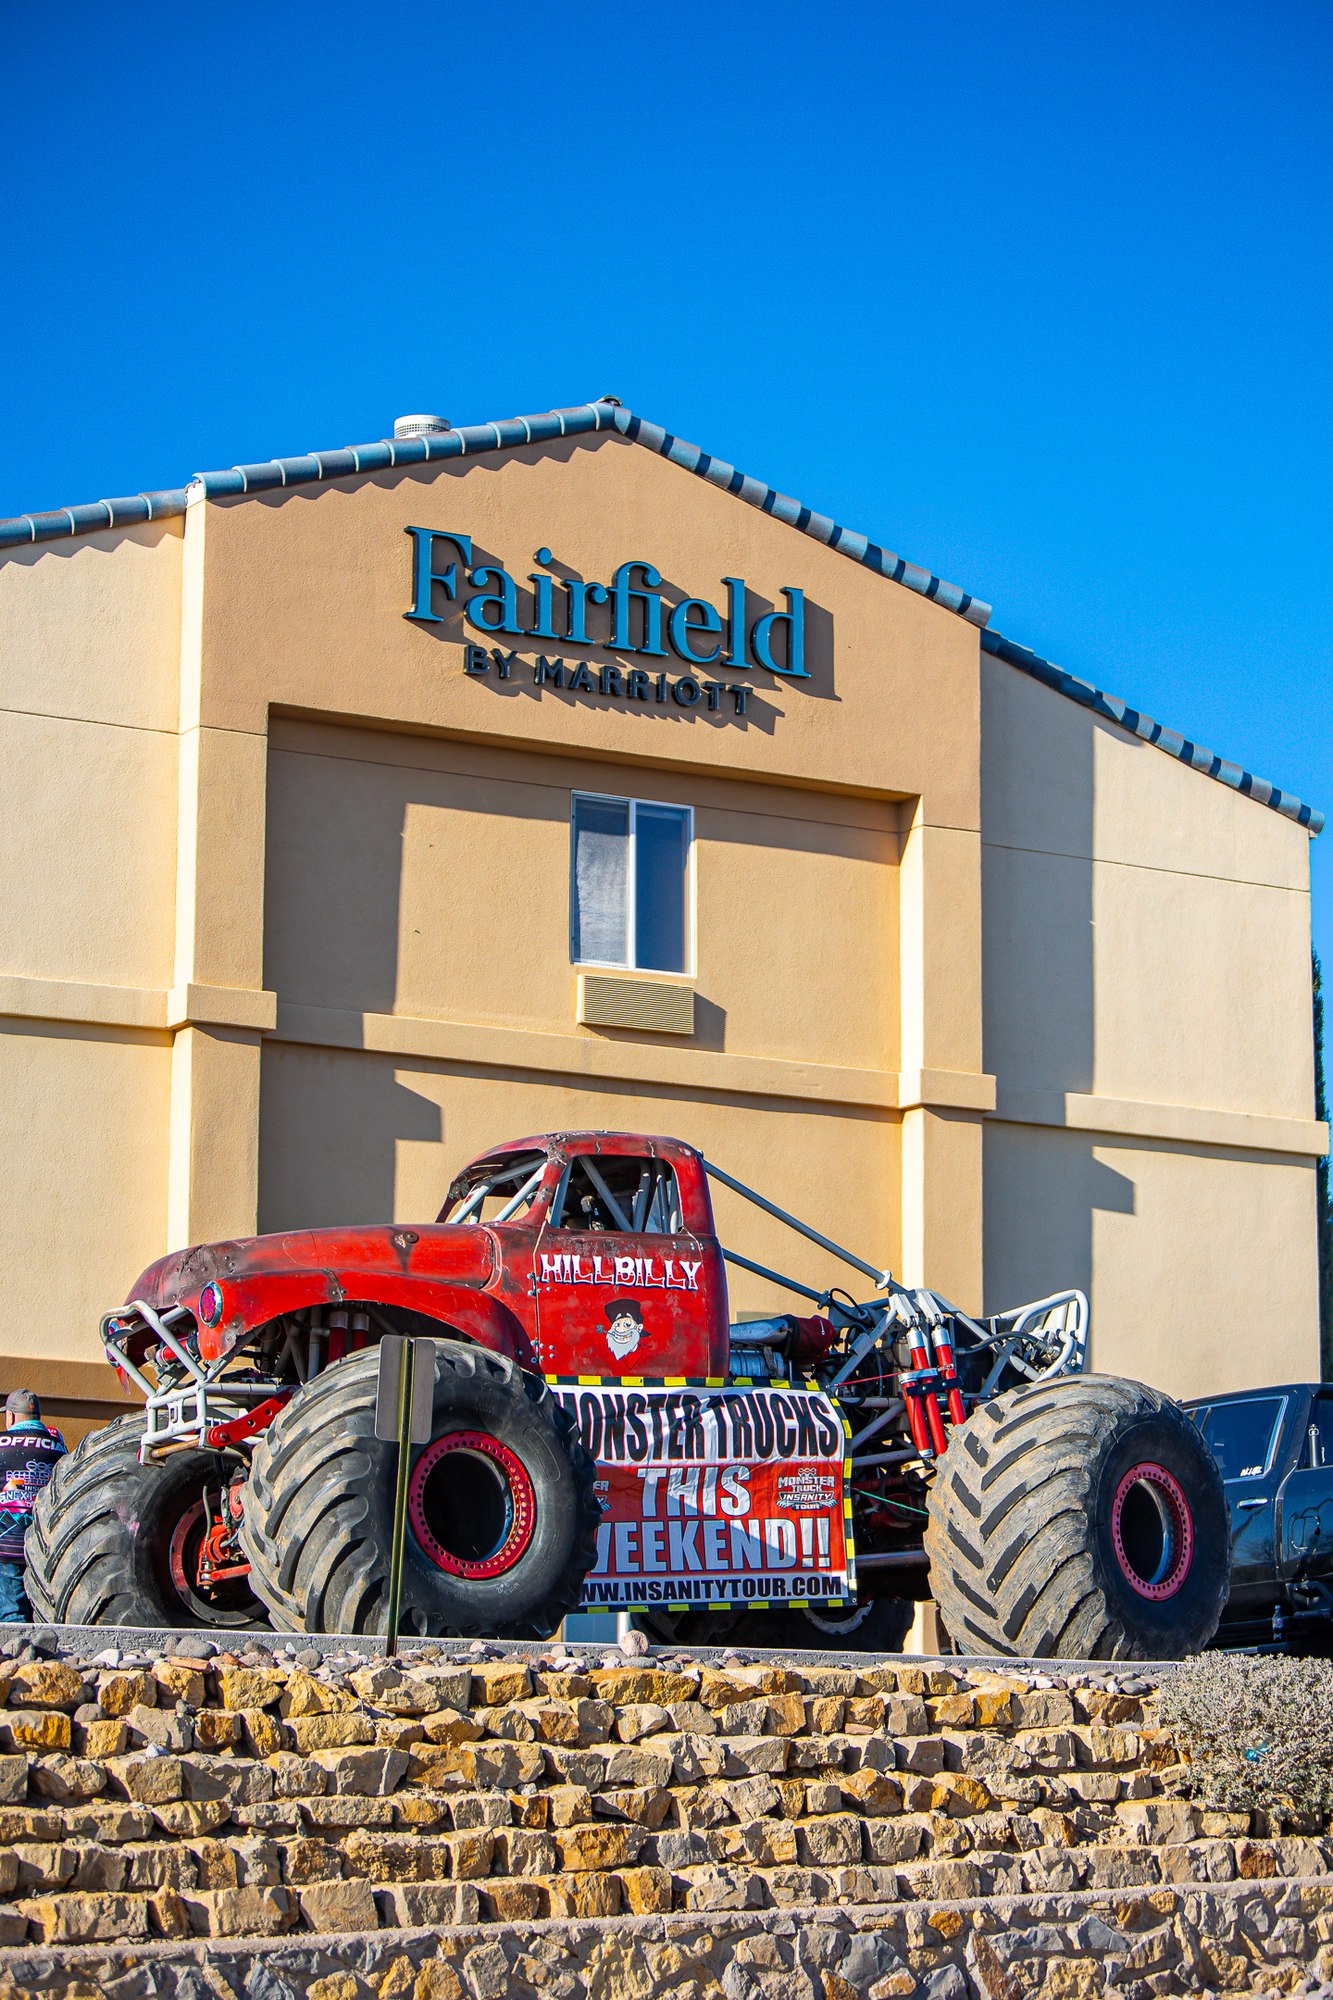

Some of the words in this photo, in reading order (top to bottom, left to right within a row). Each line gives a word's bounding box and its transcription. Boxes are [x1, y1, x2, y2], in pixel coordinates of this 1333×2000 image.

[403, 526, 812, 678] Fairfield
[463, 645, 518, 679] BY
[534, 655, 753, 715] MARRIOTT
[540, 1253, 702, 1291] HILLBILLY
[707, 1391, 840, 1460] TRUCKS
[637, 1464, 752, 1518] THIS
[778, 1475, 835, 1489] MONSTER
[783, 1493, 831, 1502] INSANITY
[791, 1484, 822, 1492] TRUCK
[581, 1576, 842, 1603] WW.INSANITYTOUR.COM
